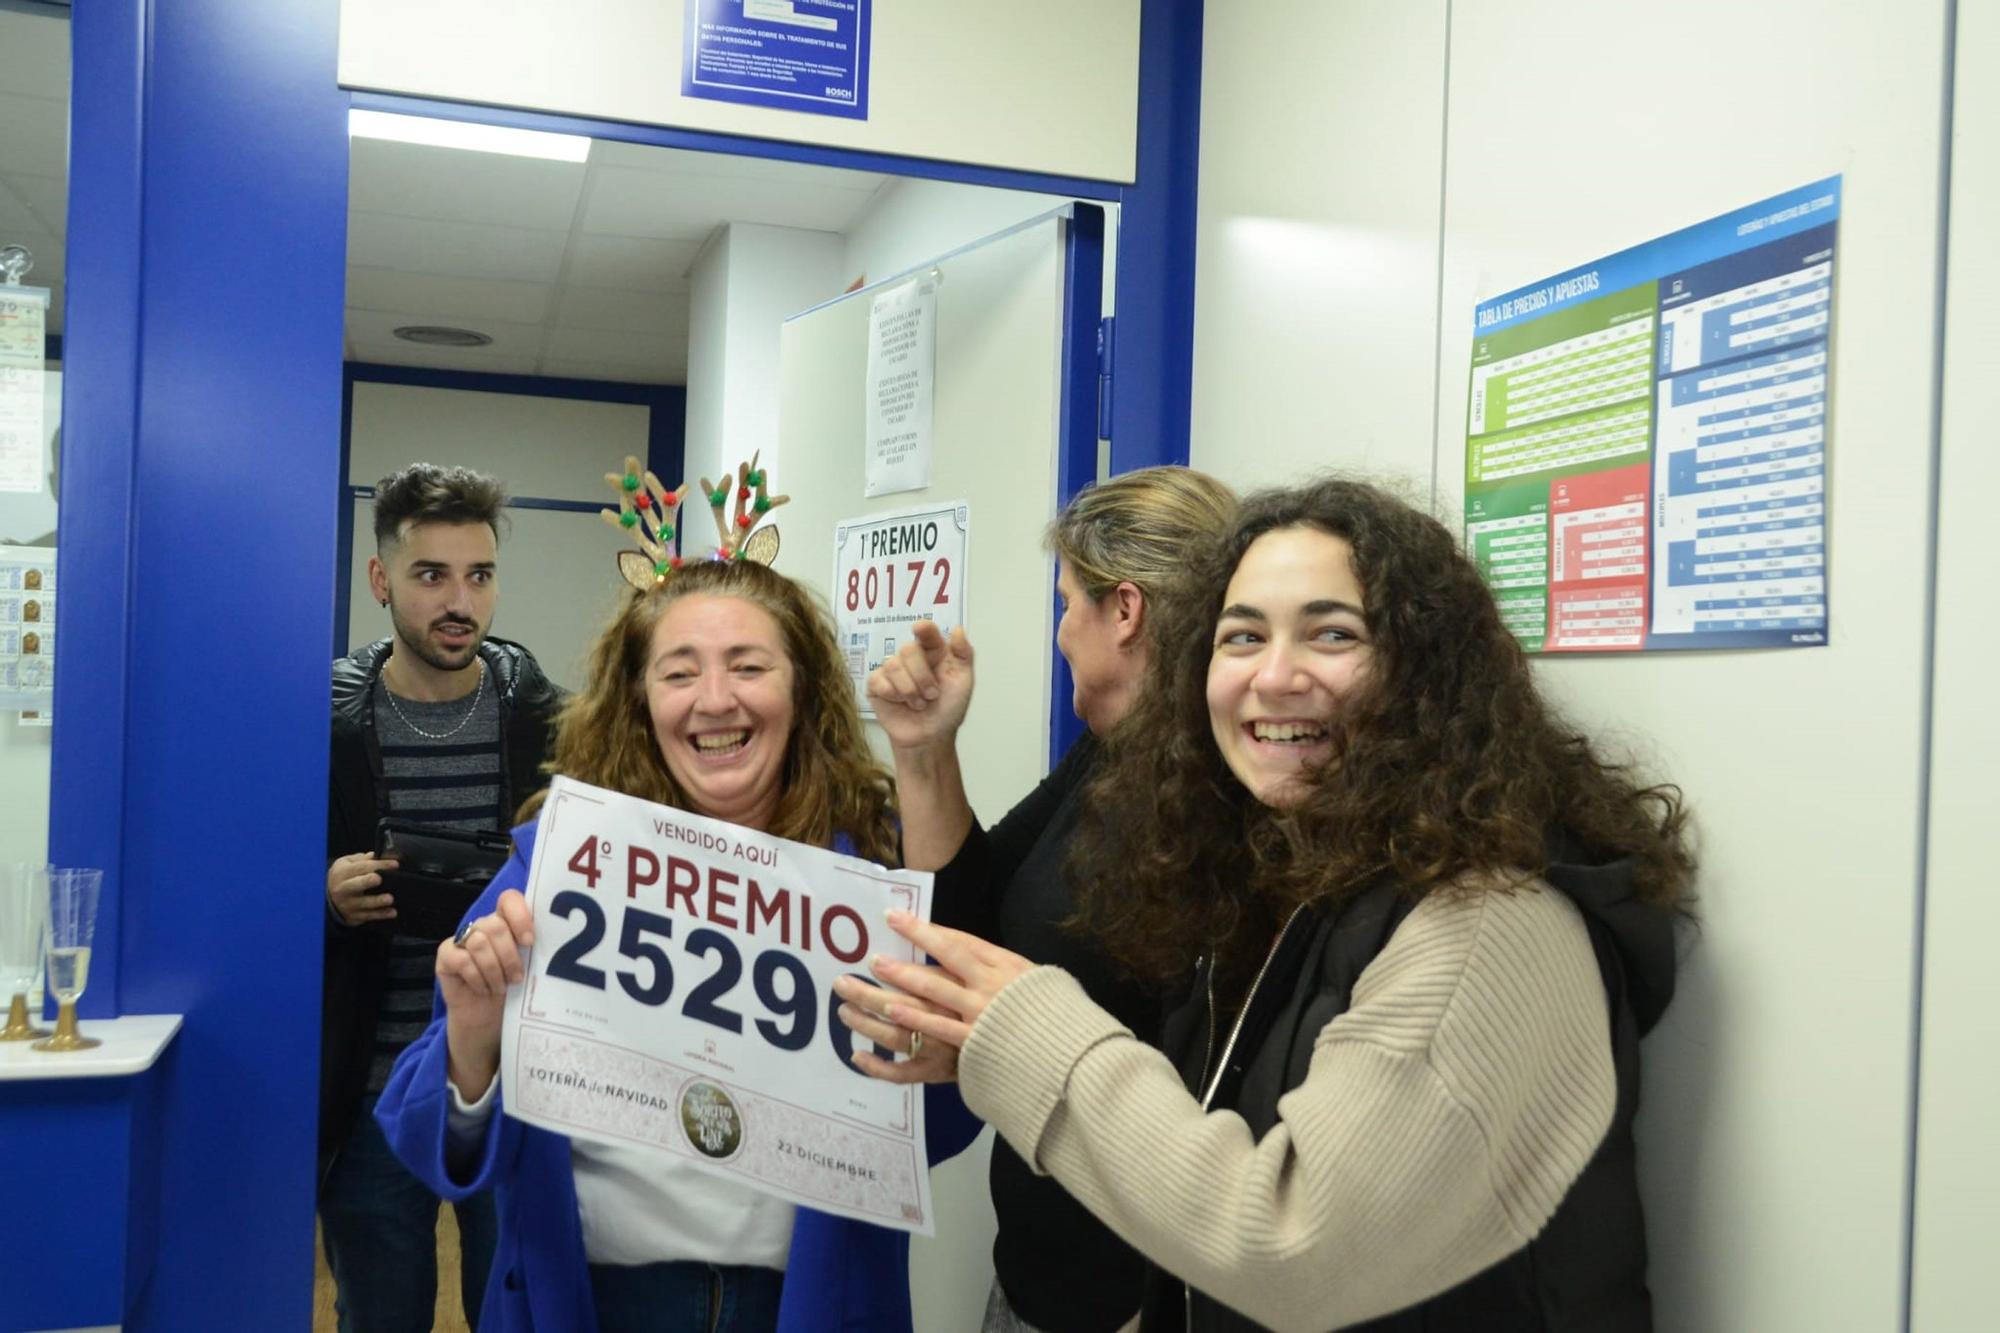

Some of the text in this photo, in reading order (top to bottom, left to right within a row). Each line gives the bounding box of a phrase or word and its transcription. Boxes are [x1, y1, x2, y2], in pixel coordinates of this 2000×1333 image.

[716, 25, 757, 36] INFORMACIÓN
[758, 30, 777, 39] SOBRE
[787, 35, 826, 47] TRATAMIENTO
[826, 87, 852, 98] BOSCH
[1478, 271, 1600, 328] TABLA DE PRECIOS Y APUESTAS
[871, 522, 938, 558] PREMIO
[846, 557, 951, 612] 80172
[653, 818, 779, 868] VENDIDO AQUÍ
[567, 834, 870, 964] 4º PREMIO
[605, 1084, 668, 1111] NAVIDAD
[778, 1139, 877, 1181] 22 DICIEMBRE
